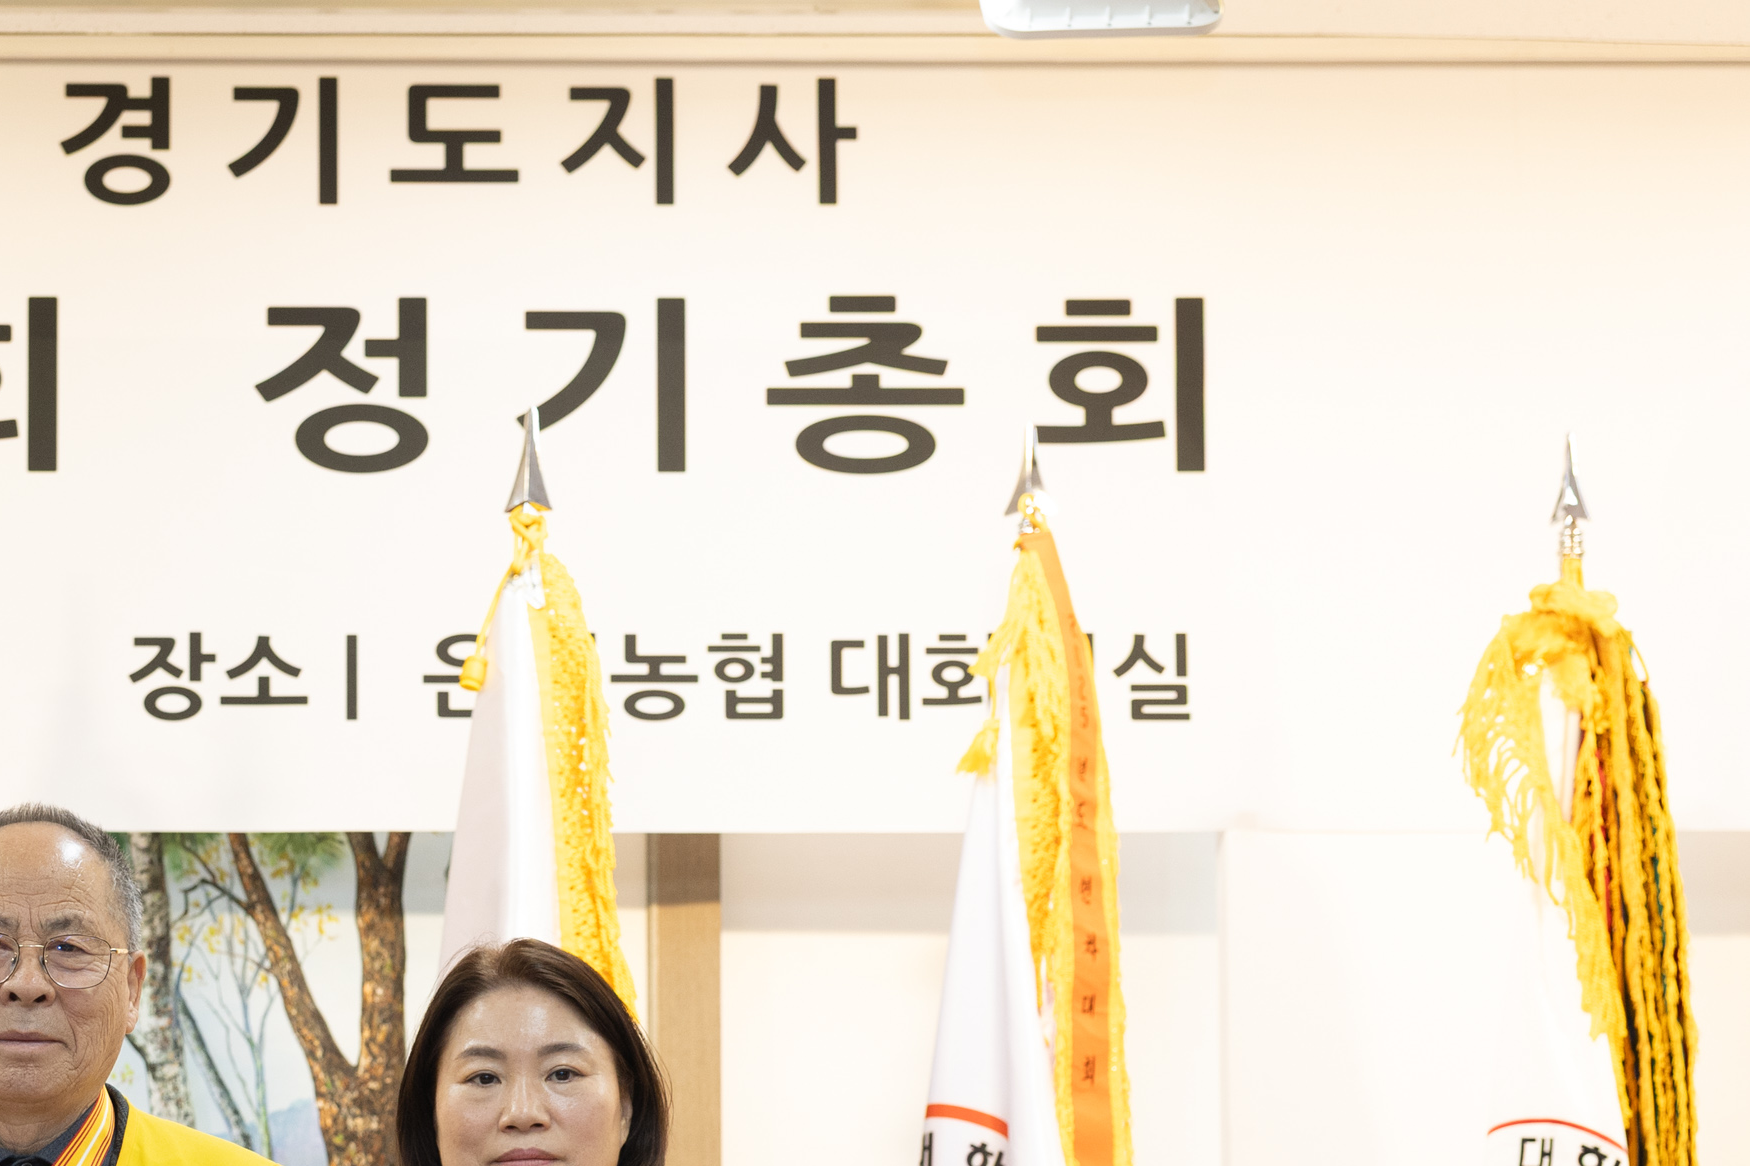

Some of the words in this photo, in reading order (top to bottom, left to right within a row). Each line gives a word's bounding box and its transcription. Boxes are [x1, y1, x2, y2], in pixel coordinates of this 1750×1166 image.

[60, 75, 858, 206] 경기도지사
[255, 295, 1205, 475] 정기총회
[423, 633, 784, 721] 은농협
[831, 633, 1191, 721] 대회실
